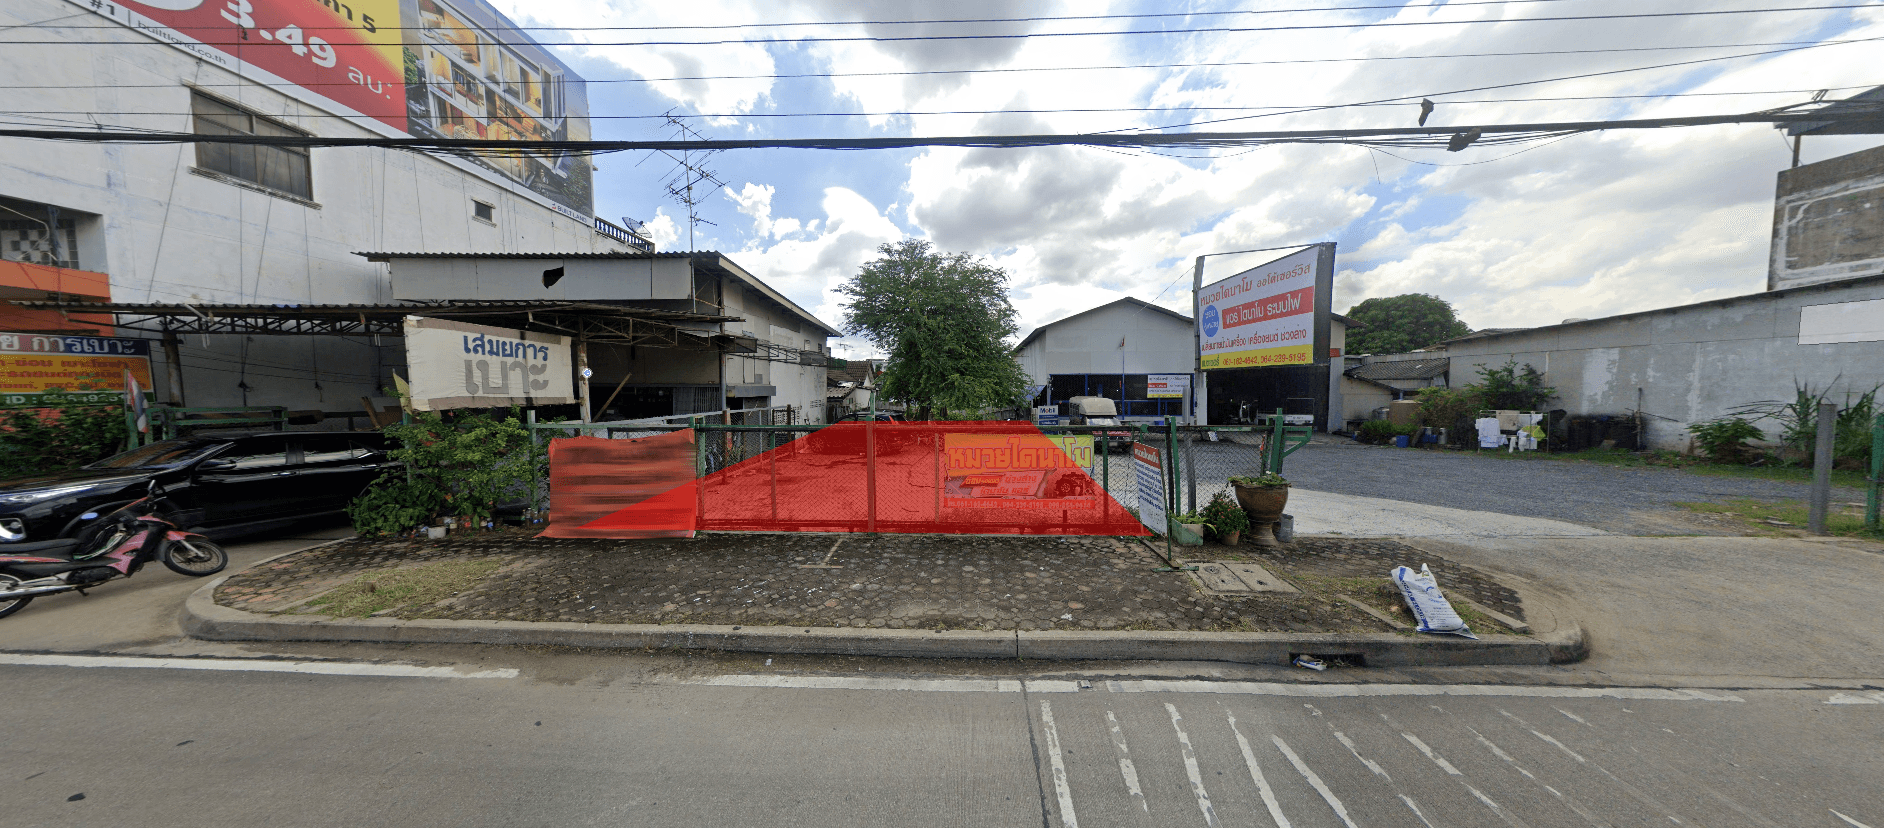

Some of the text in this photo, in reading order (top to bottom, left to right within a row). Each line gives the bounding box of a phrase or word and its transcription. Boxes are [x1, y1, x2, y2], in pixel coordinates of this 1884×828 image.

[89, 0, 116, 16] #1
[362, 13, 377, 34] 5
[137, 20, 226, 65] builtland.co.th
[557, 205, 587, 223] BUILT LAND
[1200, 263, 1311, 306] หมวยไดนาโม ออโต้เซอร์วิส
[1239, 302, 1265, 322] ไดนาโม
[1266, 293, 1302, 316] ระบบไฟ
[31, 337, 136, 354] การเบาะ
[1281, 324, 1307, 341] ช่วงล่าง
[463, 333, 549, 361] เสมยการ
[464, 359, 550, 395] เบาะ
[947, 434, 1092, 469] หมวยไดนาโม
